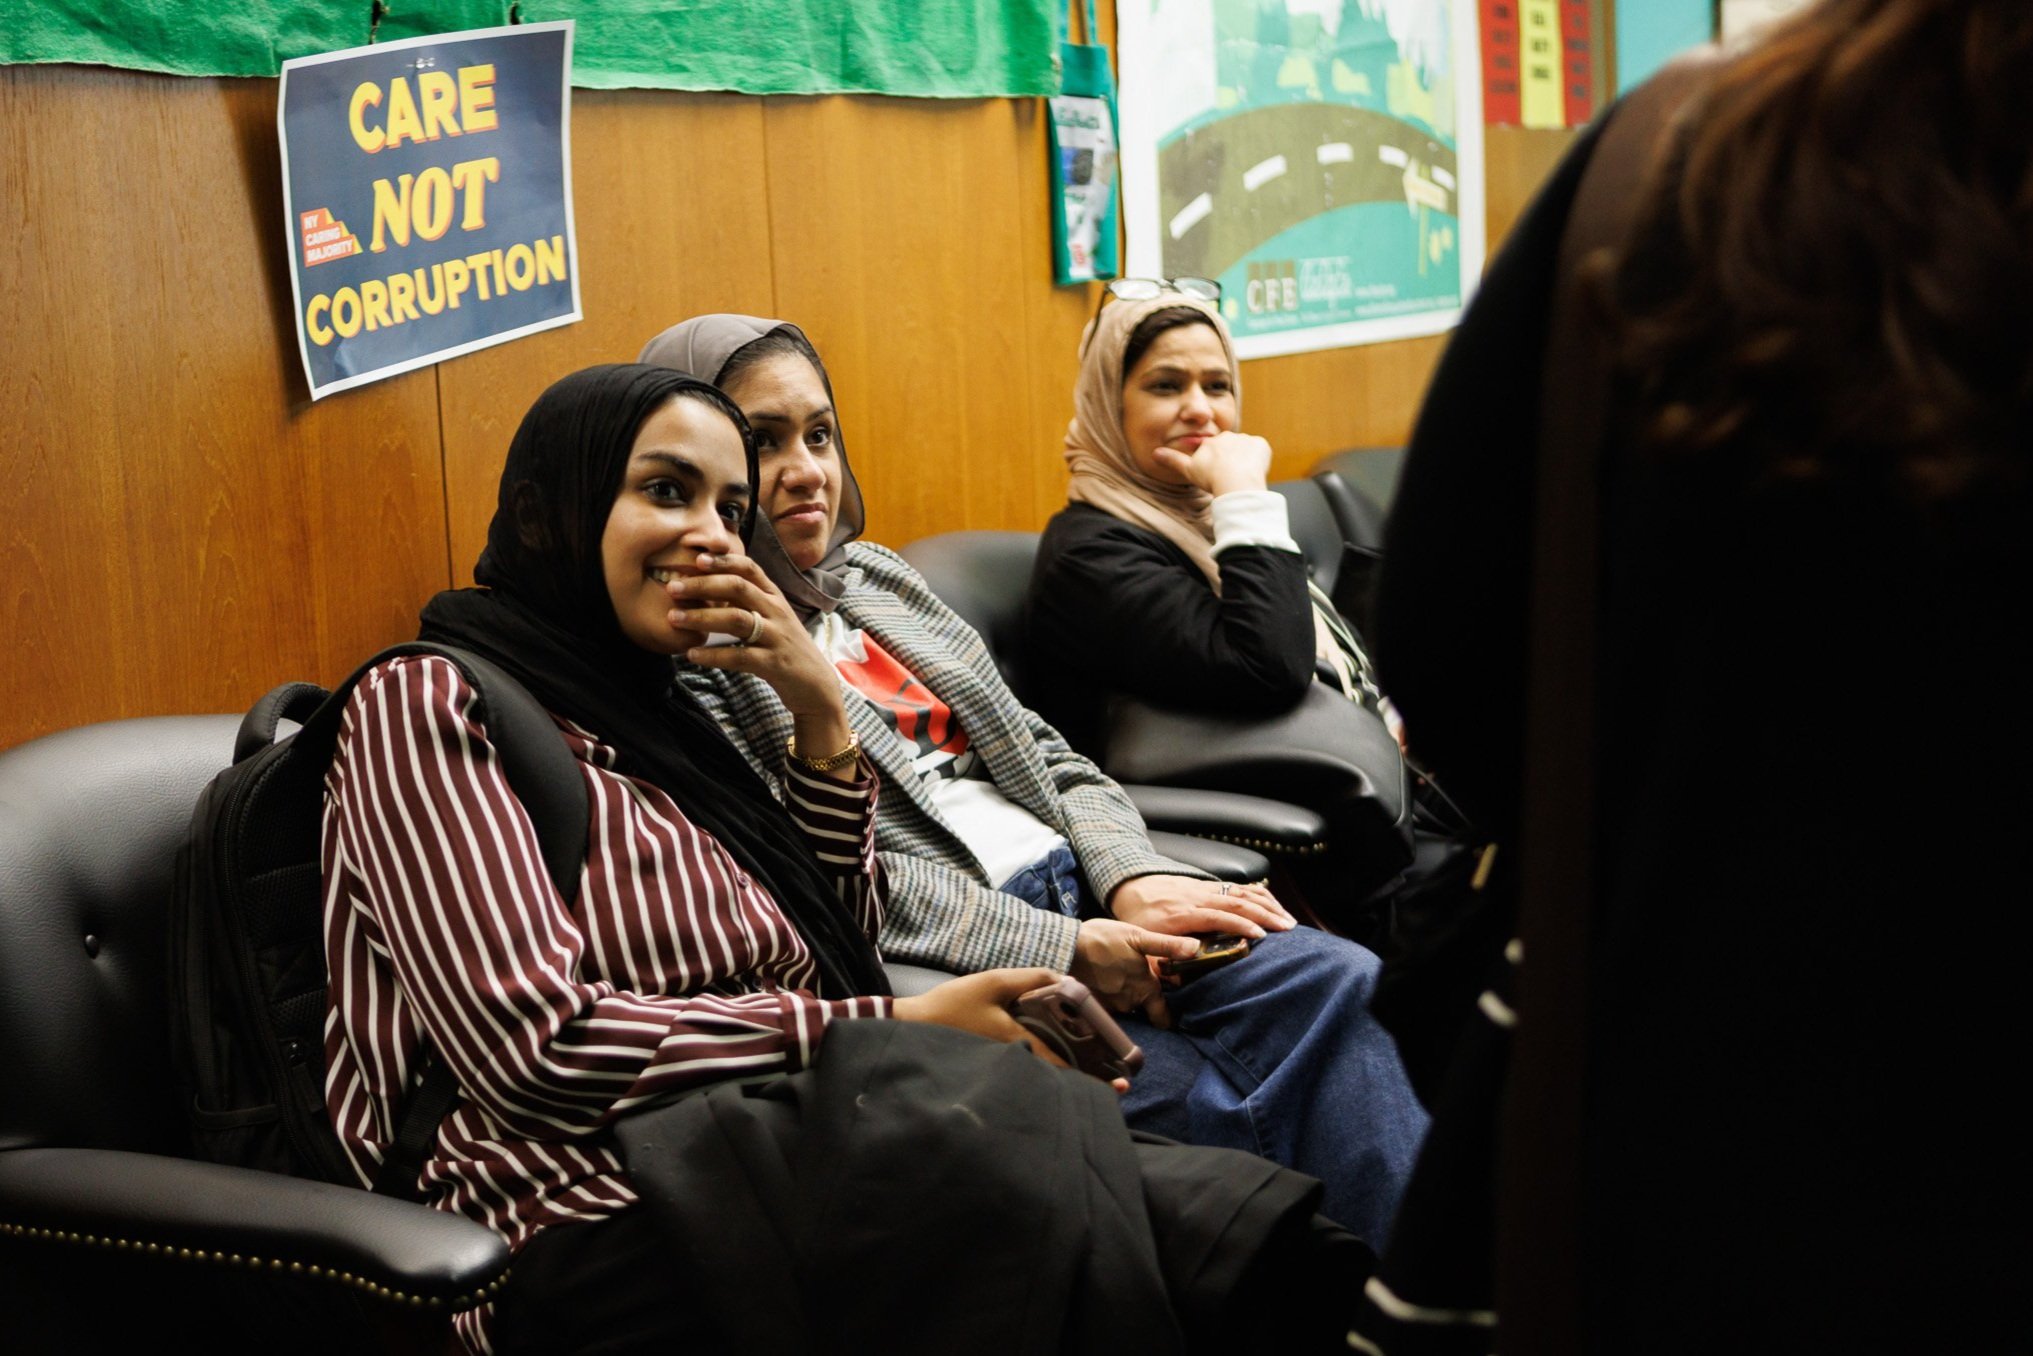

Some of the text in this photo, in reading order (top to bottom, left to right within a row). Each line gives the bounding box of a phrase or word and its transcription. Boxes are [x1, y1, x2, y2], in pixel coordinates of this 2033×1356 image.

[349, 63, 499, 154] CARE
[306, 239, 353, 263] MAJORITY
[370, 157, 500, 254] NOT
[306, 235, 567, 347] CORRUPTION
